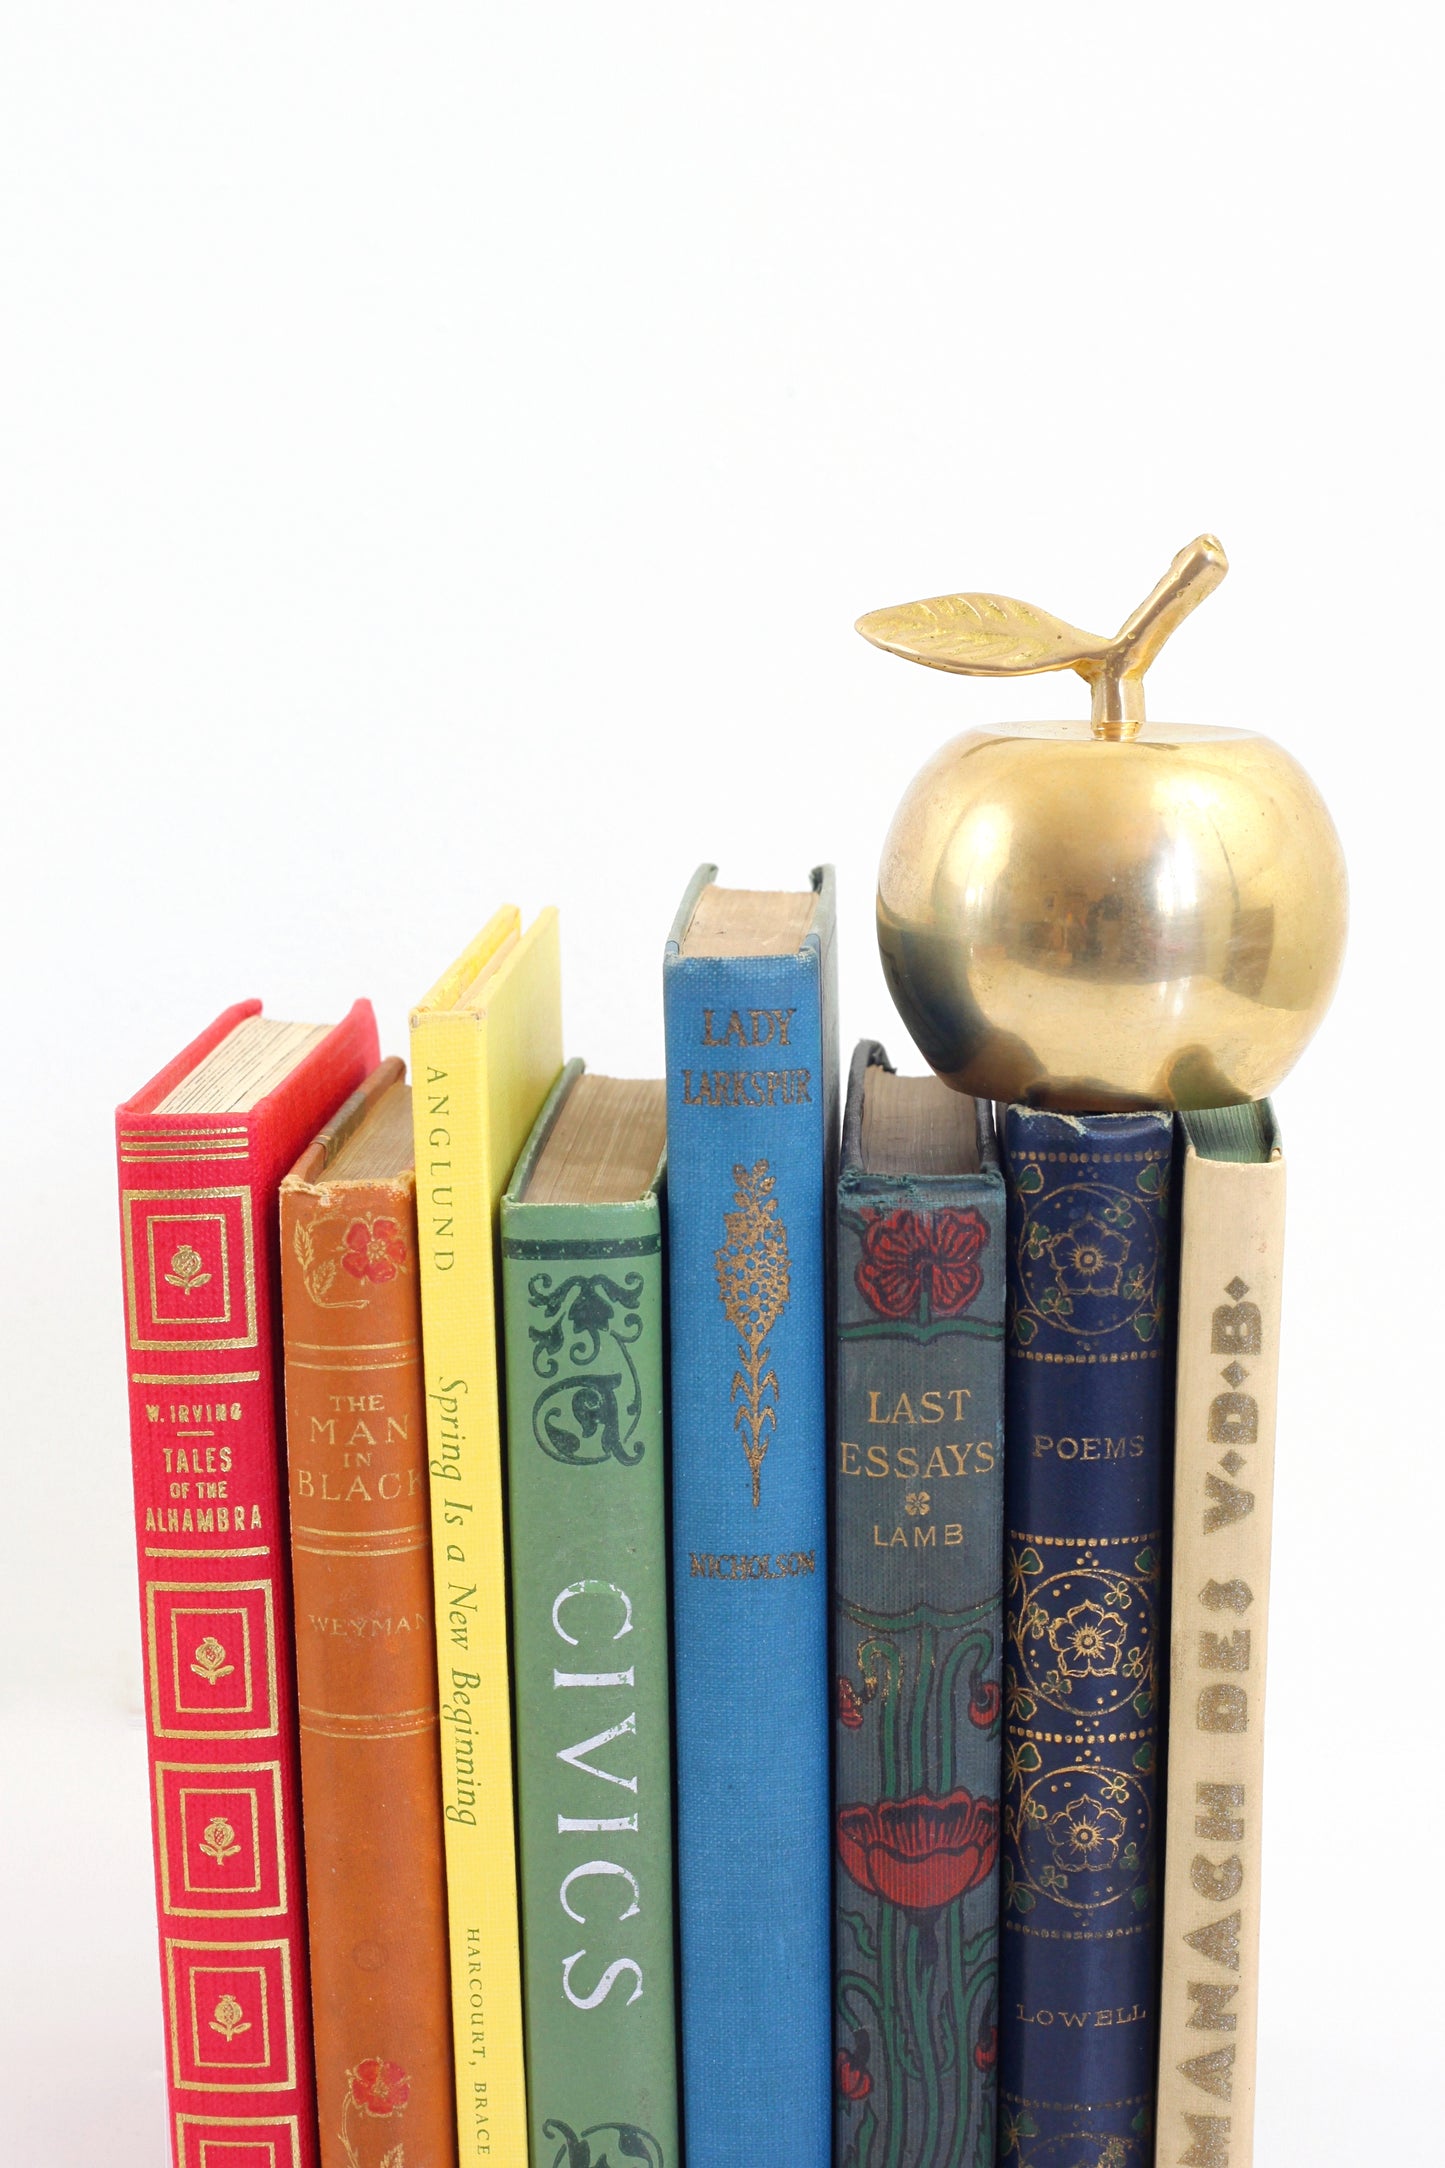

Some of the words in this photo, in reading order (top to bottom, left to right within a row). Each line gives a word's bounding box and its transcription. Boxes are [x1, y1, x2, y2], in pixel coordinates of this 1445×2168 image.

[702, 1008, 797, 1047] LADY
[682, 1068, 813, 1108] LARKSPUR
[427, 1066, 454, 1271] ANGLUND
[329, 1394, 385, 1412] THE
[868, 1389, 972, 1424] LAST
[309, 1414, 410, 1446] MAN
[429, 1376, 468, 1481] Spring
[163, 1446, 232, 1473] TALES
[343, 1452, 373, 1468] IN
[840, 1442, 995, 1479] ESSAYS
[1032, 1434, 1145, 1461] POEMS
[170, 1482, 190, 1499] OF
[196, 1480, 228, 1499] THE
[145, 1504, 262, 1532] ALHAMBRA
[444, 1498, 473, 1526] Is
[873, 1523, 964, 1547] LAMB
[446, 1544, 465, 1562] a
[689, 1549, 816, 1581] NICHOLSON
[447, 1583, 478, 1650] New
[1196, 1577, 1255, 1734] DES
[442, 1667, 481, 1826] Beginning
[552, 1579, 643, 2010] CIVICS
[467, 1928, 486, 2066] HARCOURT,
[1016, 2003, 1146, 2028] LOWELL
[474, 2082, 490, 2155] BRACE
